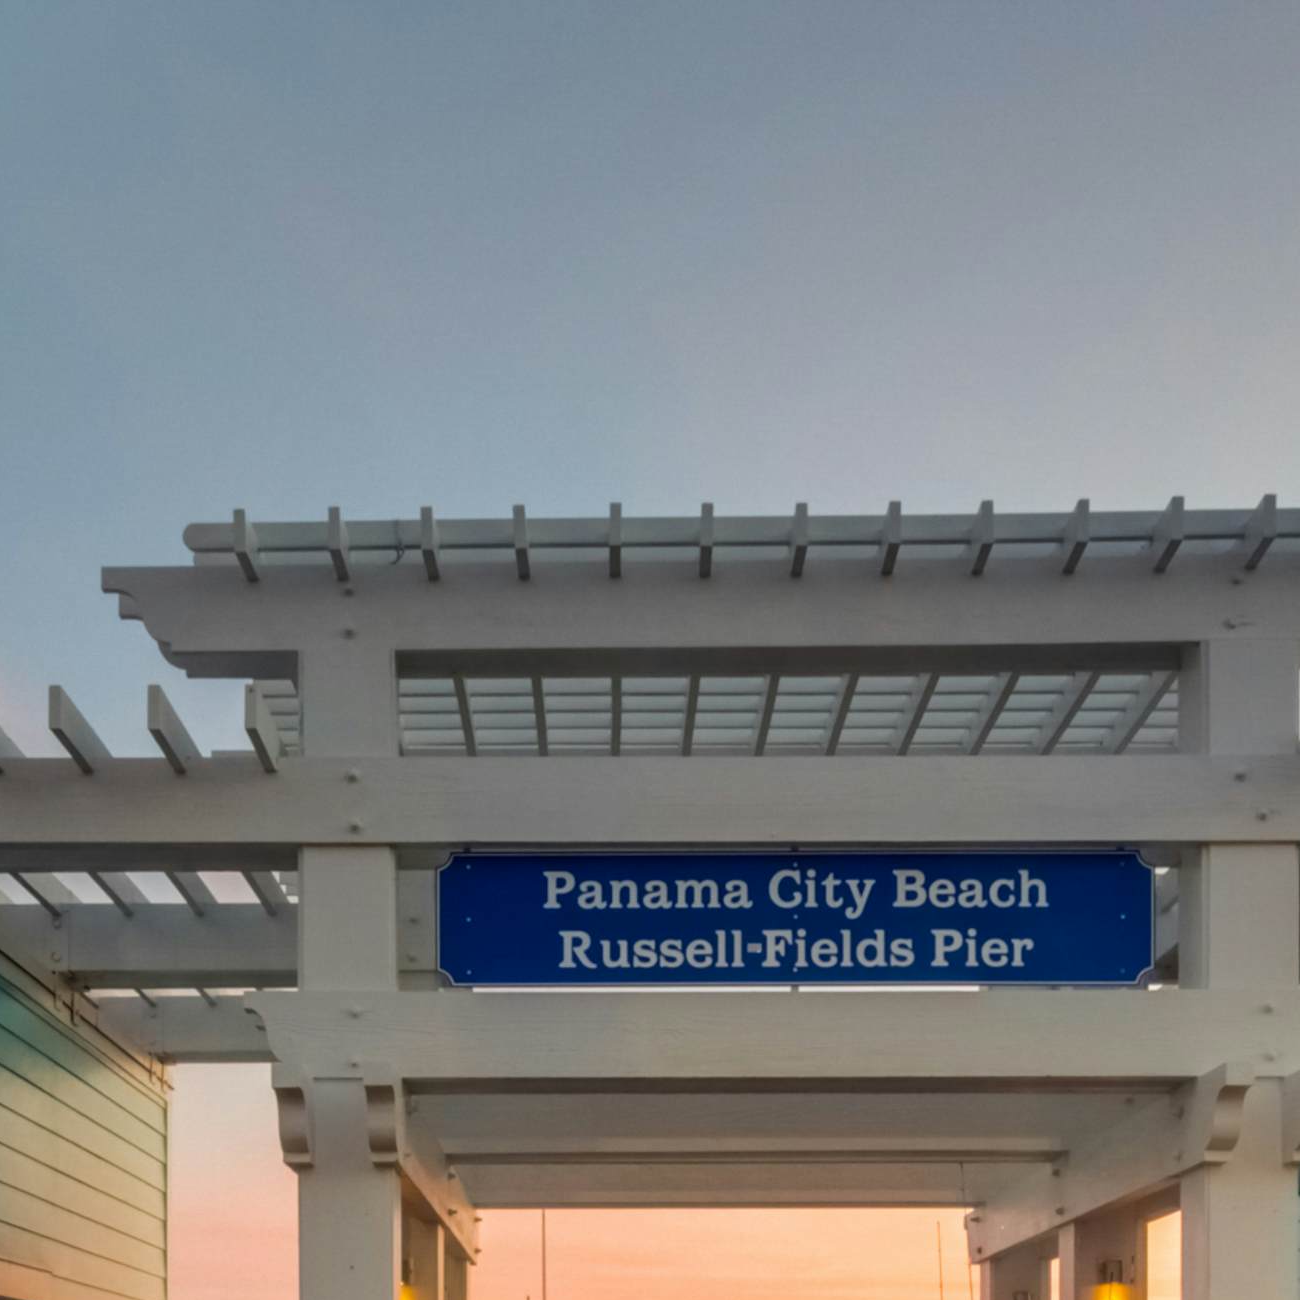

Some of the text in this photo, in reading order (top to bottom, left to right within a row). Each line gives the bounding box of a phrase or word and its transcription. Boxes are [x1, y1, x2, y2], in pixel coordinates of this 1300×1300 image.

[543, 869, 1048, 918] Panama City Beach
[558, 929, 1035, 969] Russell-Fields Pier
